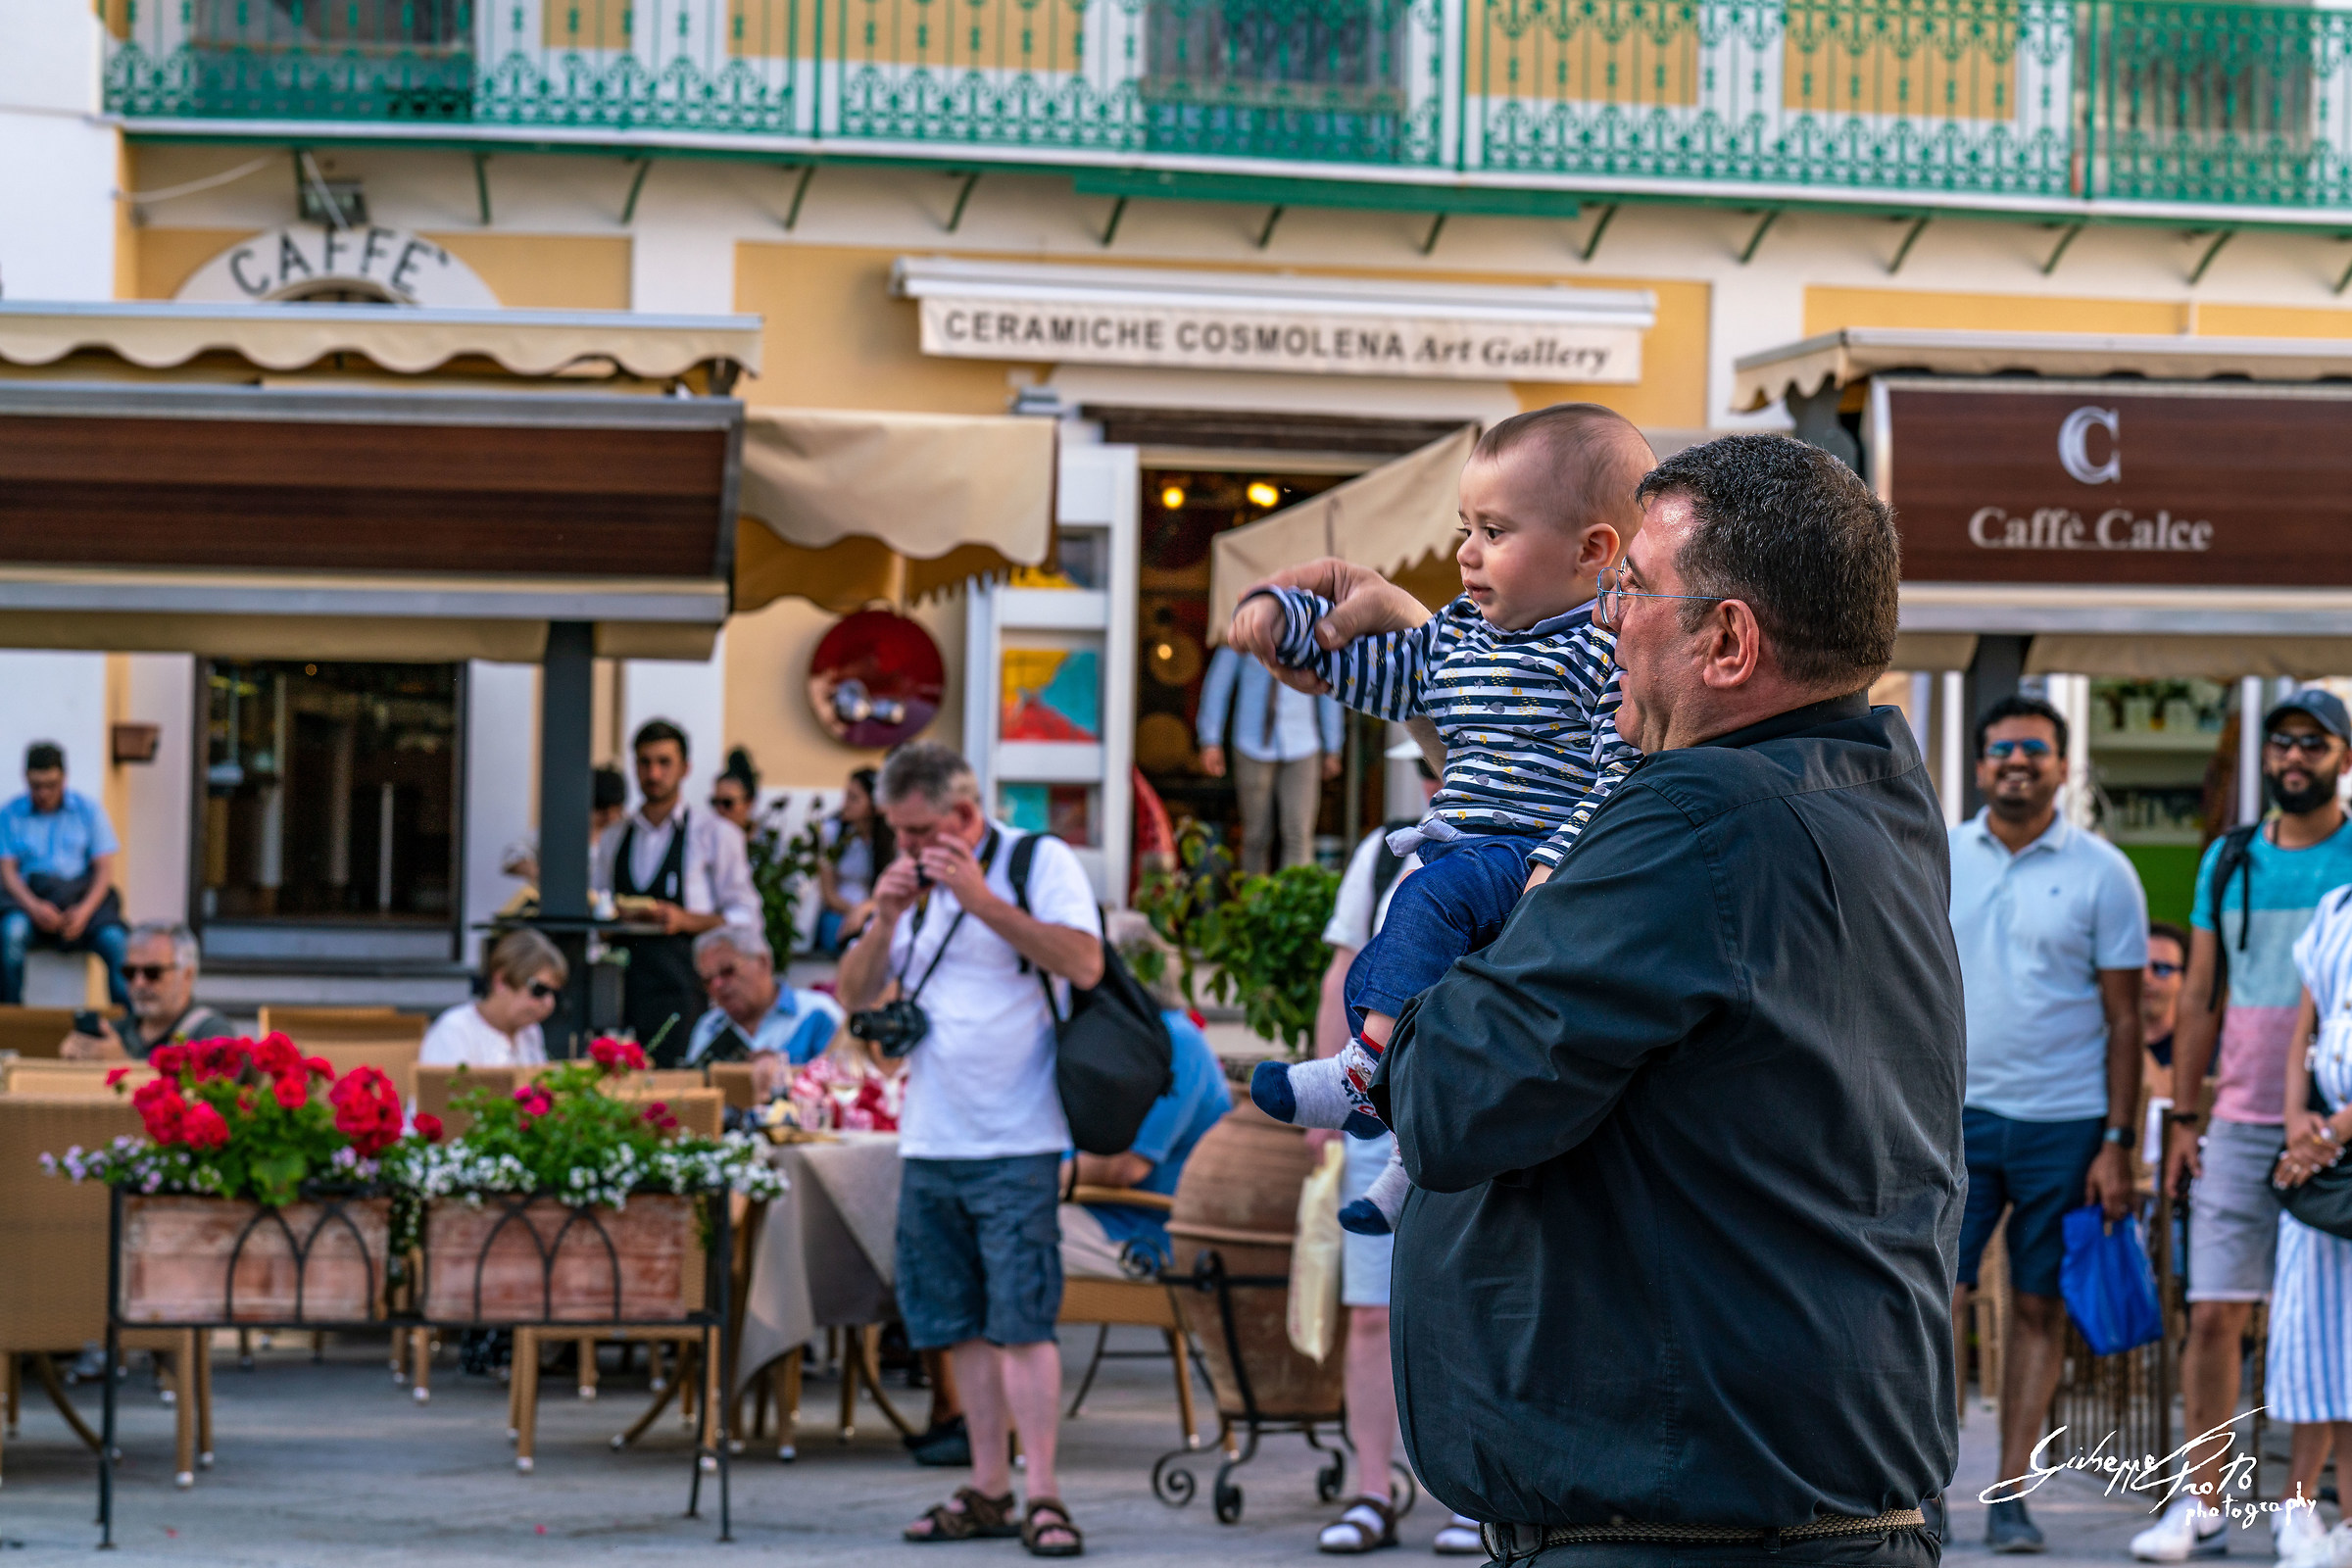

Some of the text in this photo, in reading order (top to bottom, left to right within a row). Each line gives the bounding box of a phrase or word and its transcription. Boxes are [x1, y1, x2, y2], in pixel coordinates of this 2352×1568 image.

[944, 309, 1610, 375] CERAMICHE COSMOLENA Art Gallery
[2058, 405, 2122, 485] C
[2094, 507, 2216, 552] Calce
